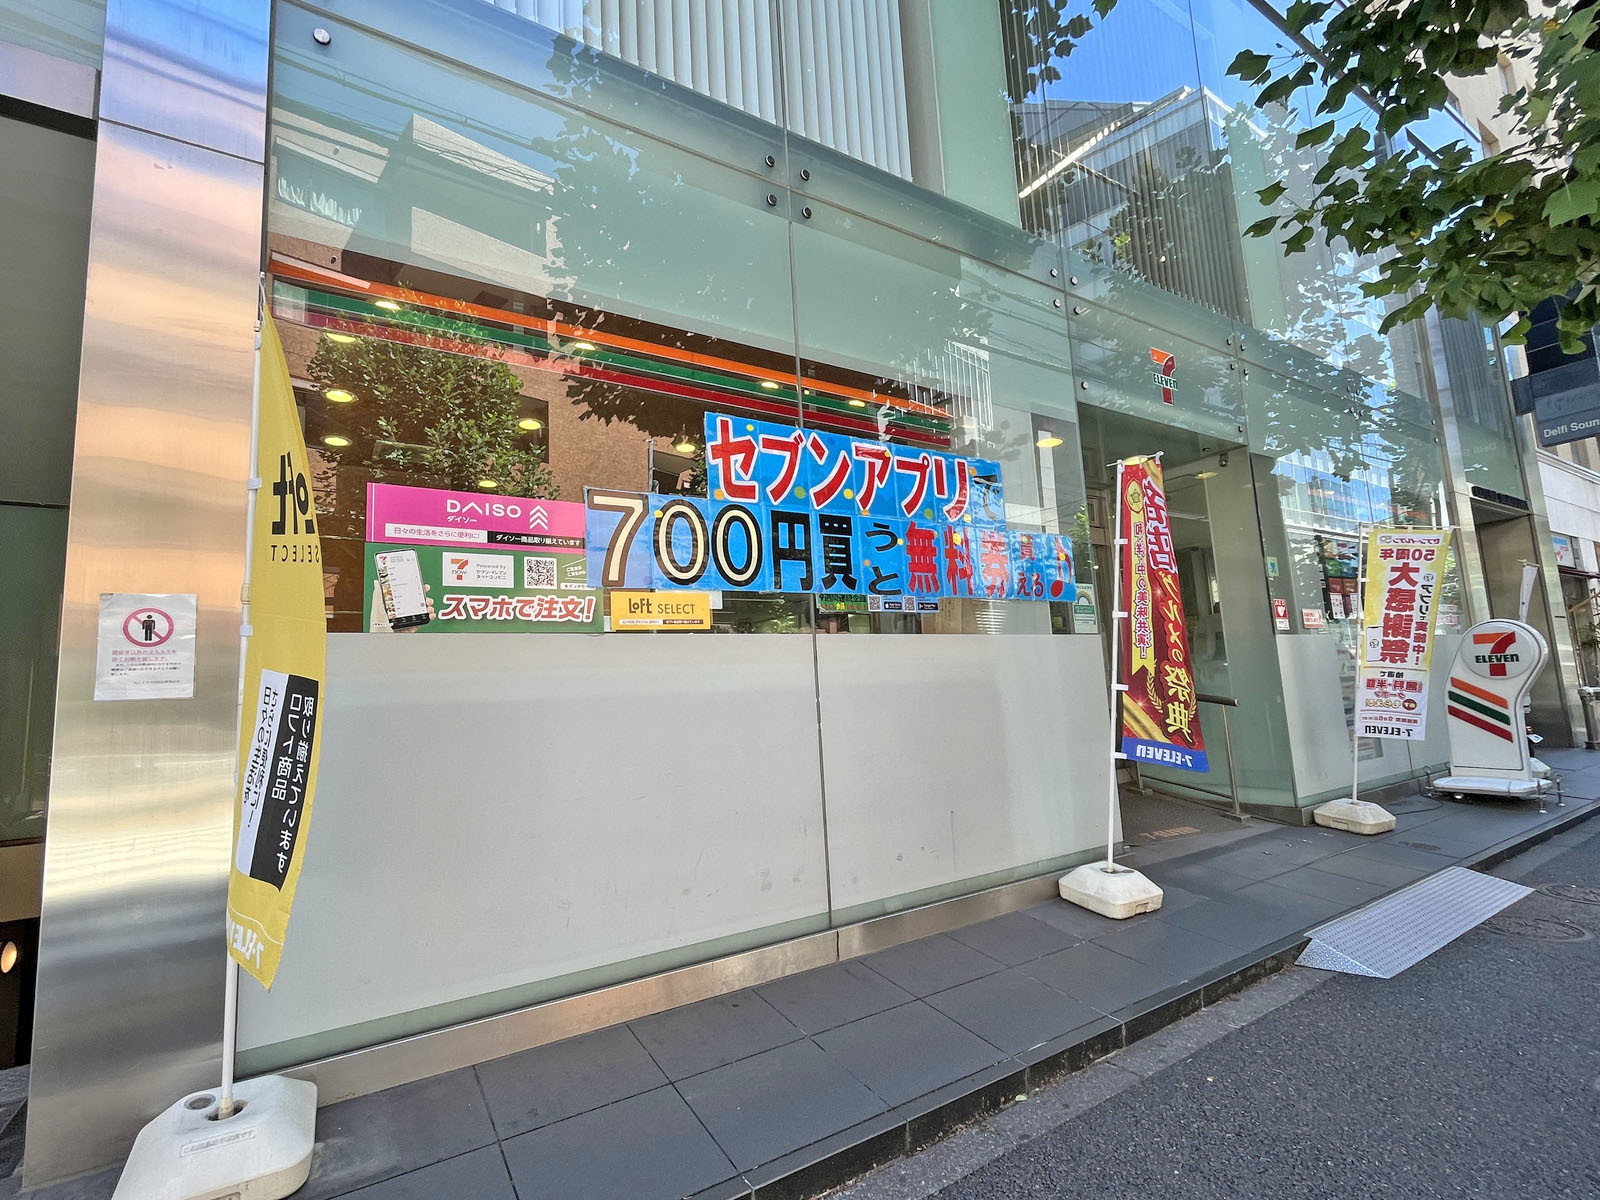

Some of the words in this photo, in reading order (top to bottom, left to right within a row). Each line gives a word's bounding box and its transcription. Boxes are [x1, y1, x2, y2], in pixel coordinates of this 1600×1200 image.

[1544, 425, 1567, 437] Delfi
[446, 500, 522, 518] DAISO
[447, 515, 477, 523] ダイソー
[440, 595, 595, 622] スマホで注文!
[657, 603, 696, 614] SELECT
